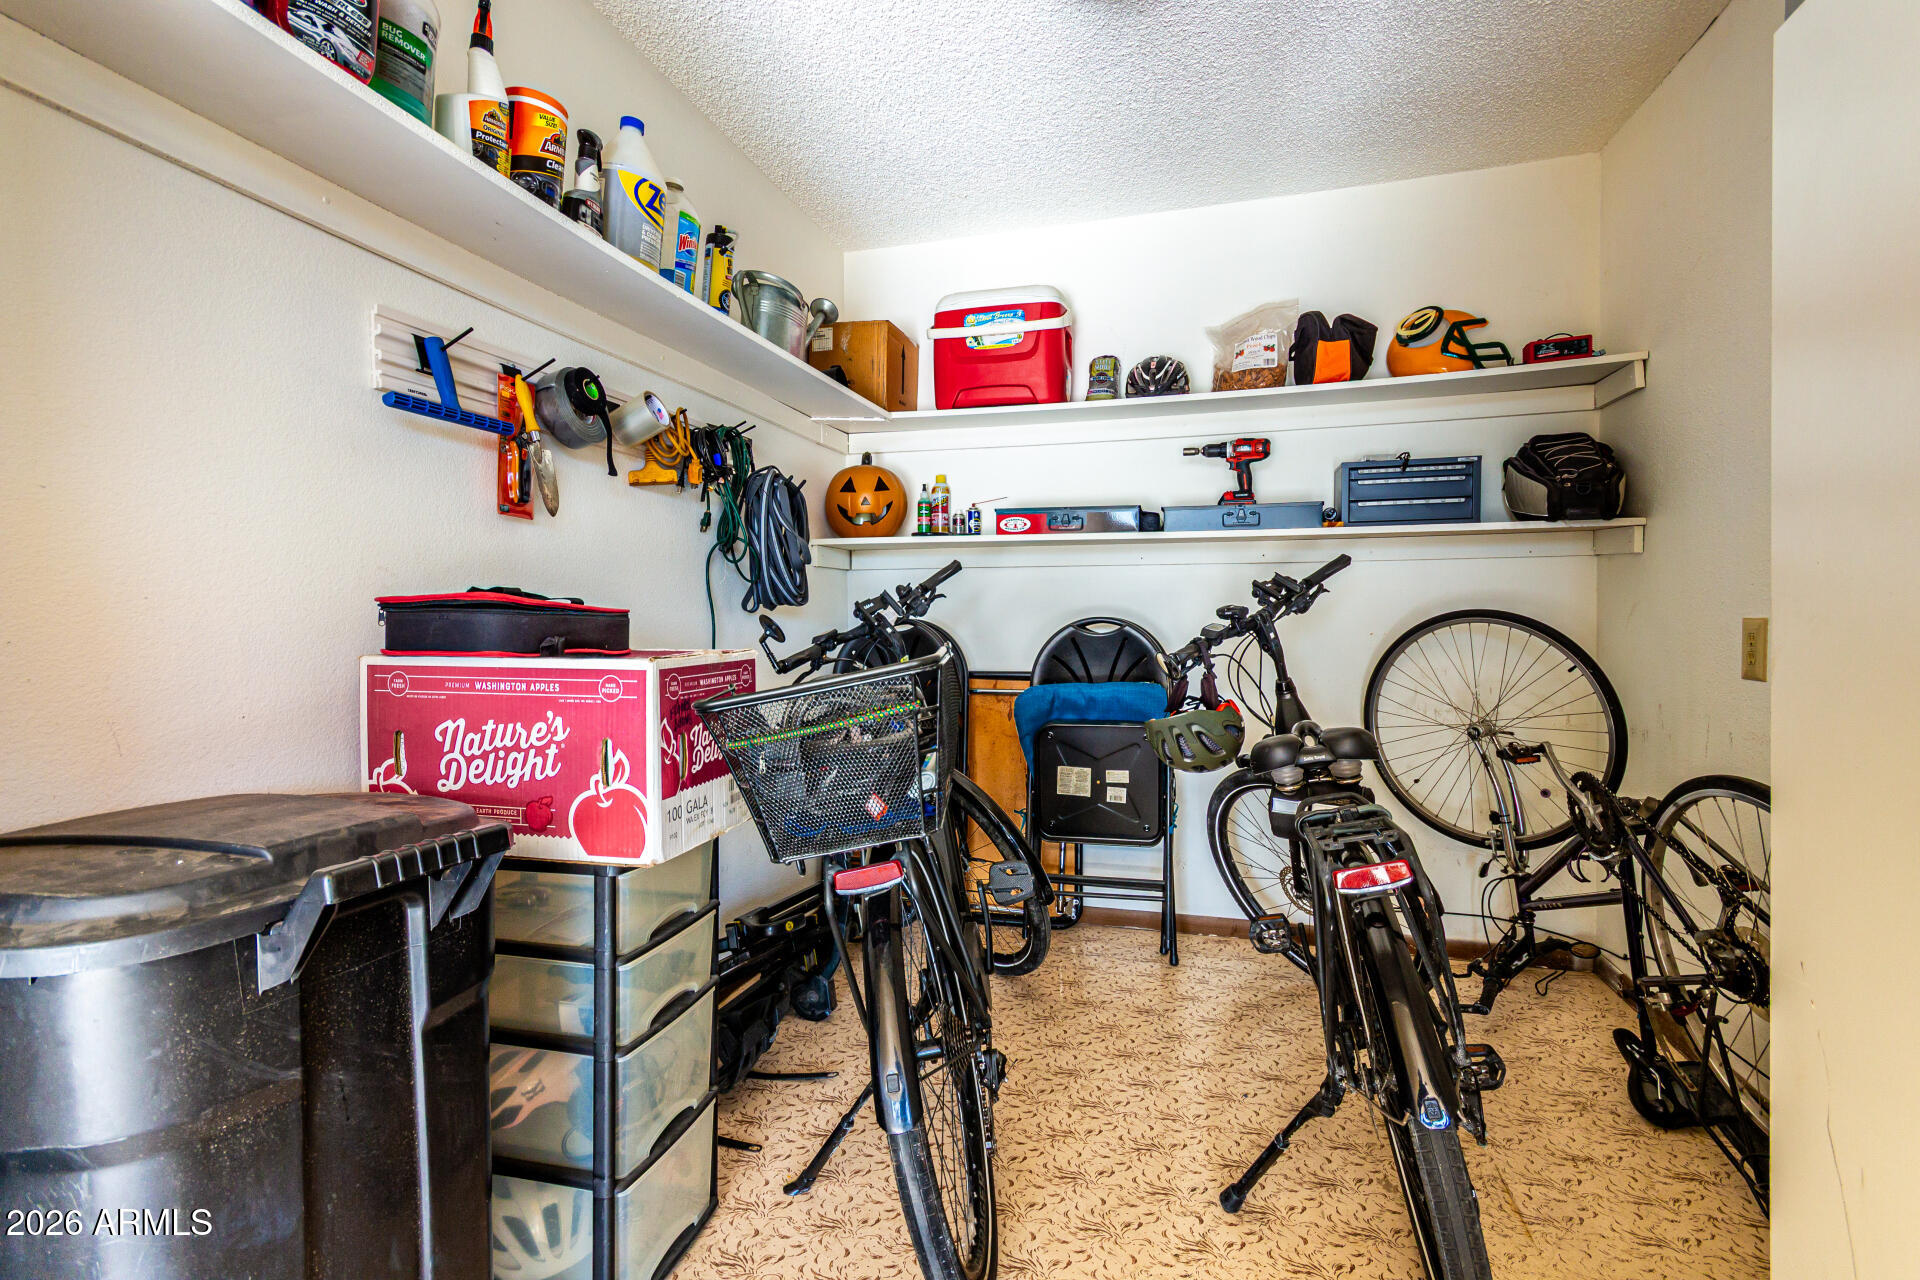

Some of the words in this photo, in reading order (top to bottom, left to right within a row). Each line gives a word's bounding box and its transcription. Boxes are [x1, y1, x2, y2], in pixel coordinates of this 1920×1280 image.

[314, 0, 338, 13] WASH
[345, 15, 372, 38] DETAILER
[382, 21, 403, 39] BUG
[382, 30, 426, 61] REMOVER
[538, 113, 556, 122] VALUE
[444, 681, 470, 689] PREMIUM
[474, 681, 527, 691] WASHINGTON
[529, 682, 560, 692] APPLES
[699, 676, 724, 686] WASHINGTON
[724, 674, 737, 682] APPLES
[434, 710, 571, 757] Nature's
[437, 743, 562, 793] Delight
[493, 808, 518, 816] PRODUCE
[667, 804, 682, 823] 100
[686, 795, 709, 814] GALA
